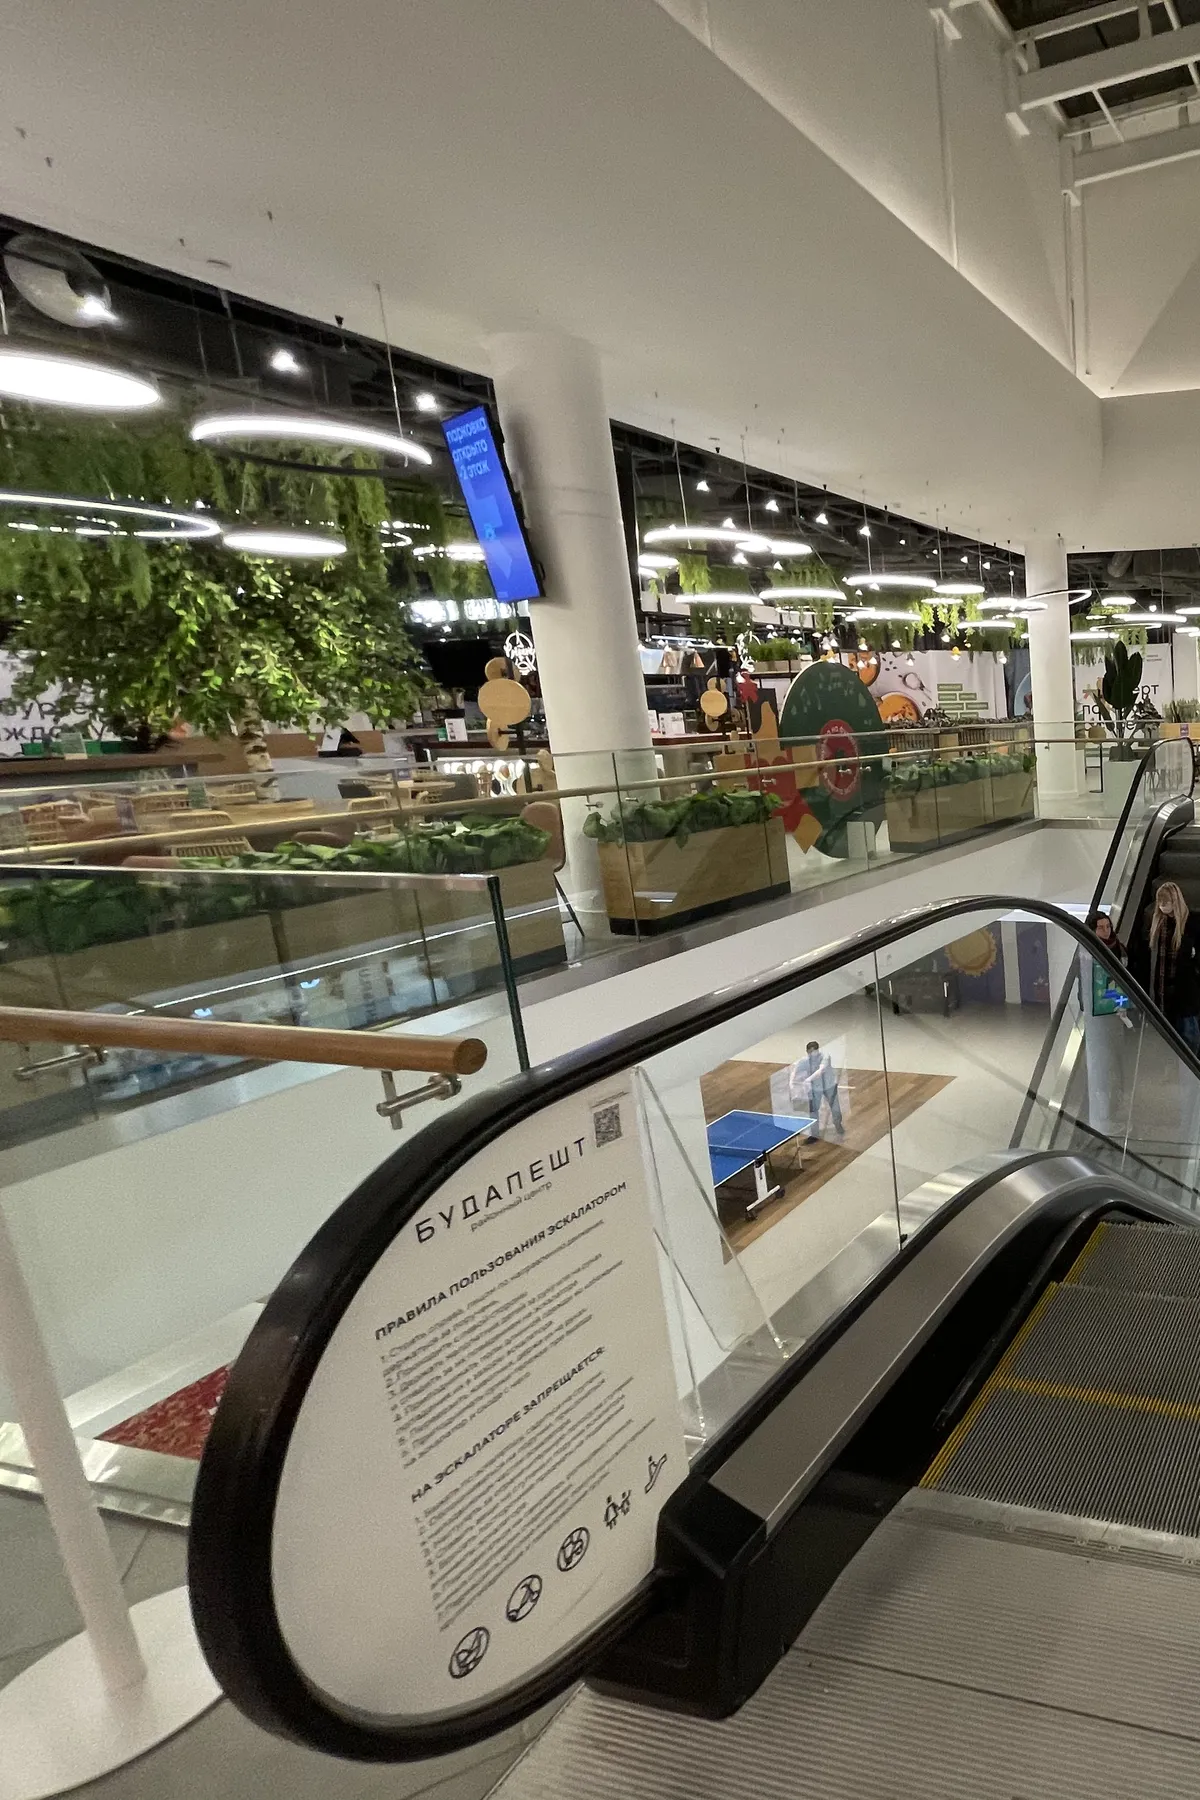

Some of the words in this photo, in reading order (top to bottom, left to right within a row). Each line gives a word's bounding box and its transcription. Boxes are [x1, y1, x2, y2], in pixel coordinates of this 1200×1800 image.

[415, 1138, 585, 1243] БУДАПЕШТ
[375, 1292, 448, 1340] ПРАВИЛА
[449, 1231, 546, 1296] ПОЛЬЗОВАНИЯ
[547, 1182, 627, 1236] ЭСКАЛАТОРОМ
[411, 1483, 432, 1503] НА
[434, 1411, 521, 1485] ЭСКАЛАТОРЕ
